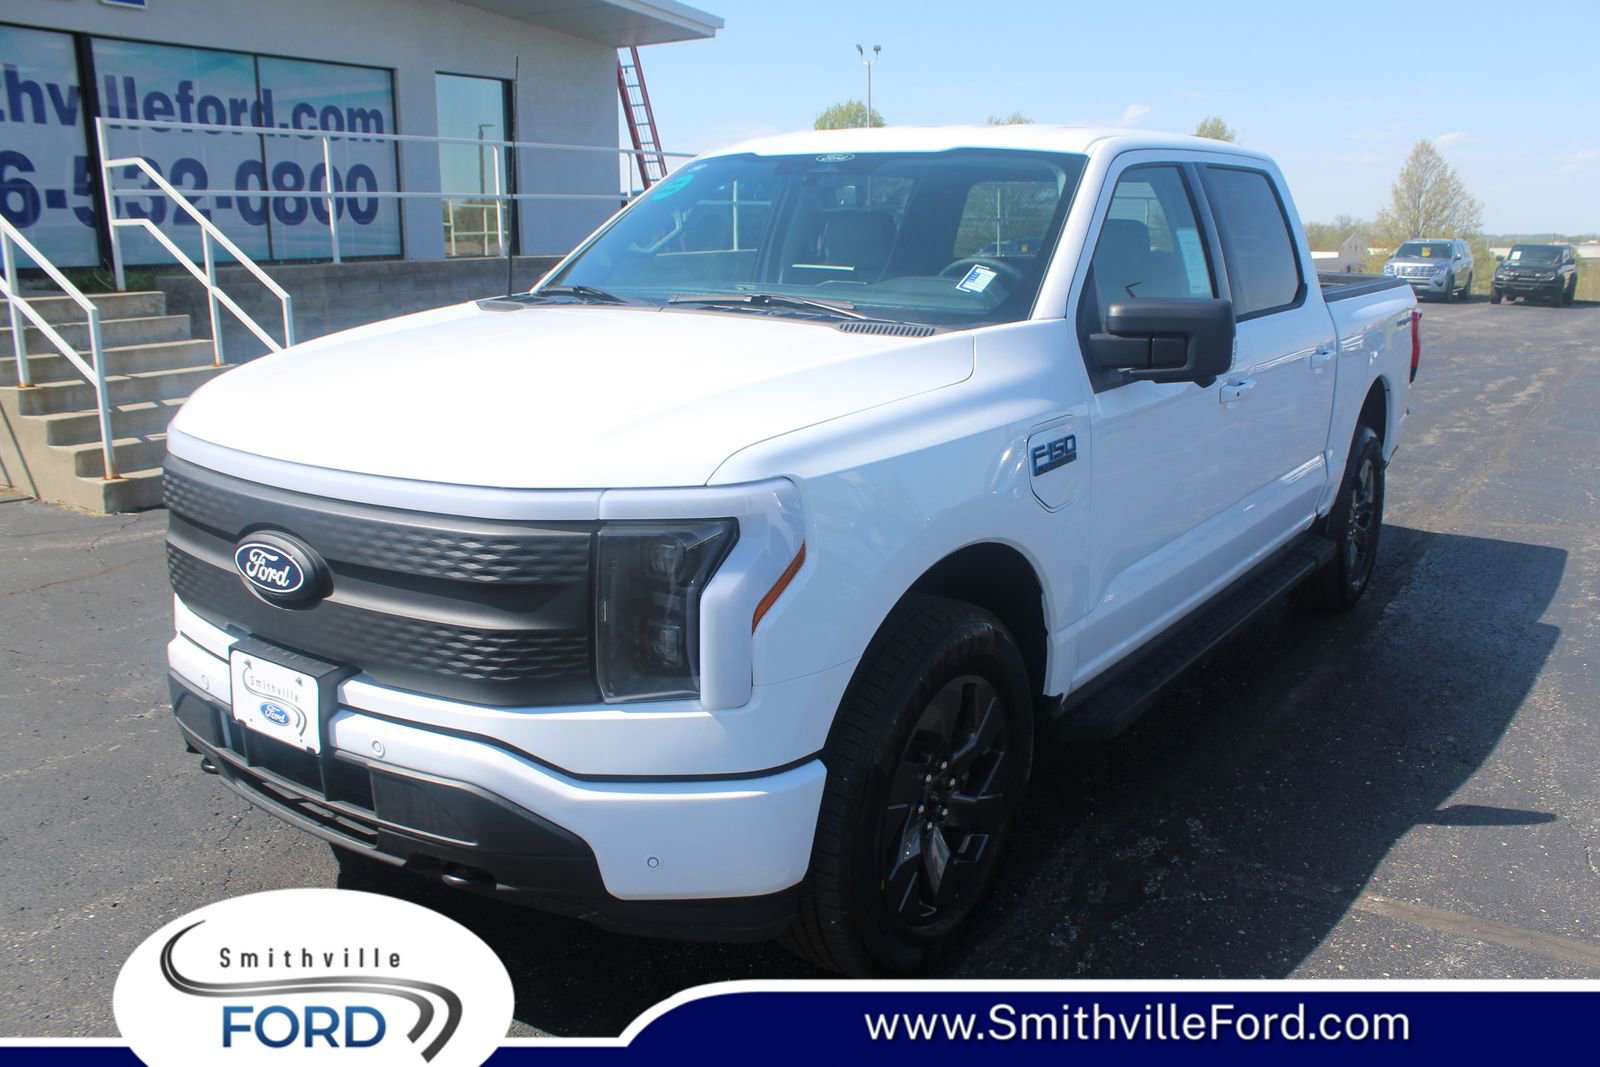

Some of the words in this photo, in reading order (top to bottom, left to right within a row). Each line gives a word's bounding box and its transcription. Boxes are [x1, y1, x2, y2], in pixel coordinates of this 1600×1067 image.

[0, 63, 385, 143] hvlleford.com
[246, 548, 290, 587] Ford
[264, 703, 287, 723] Ford
